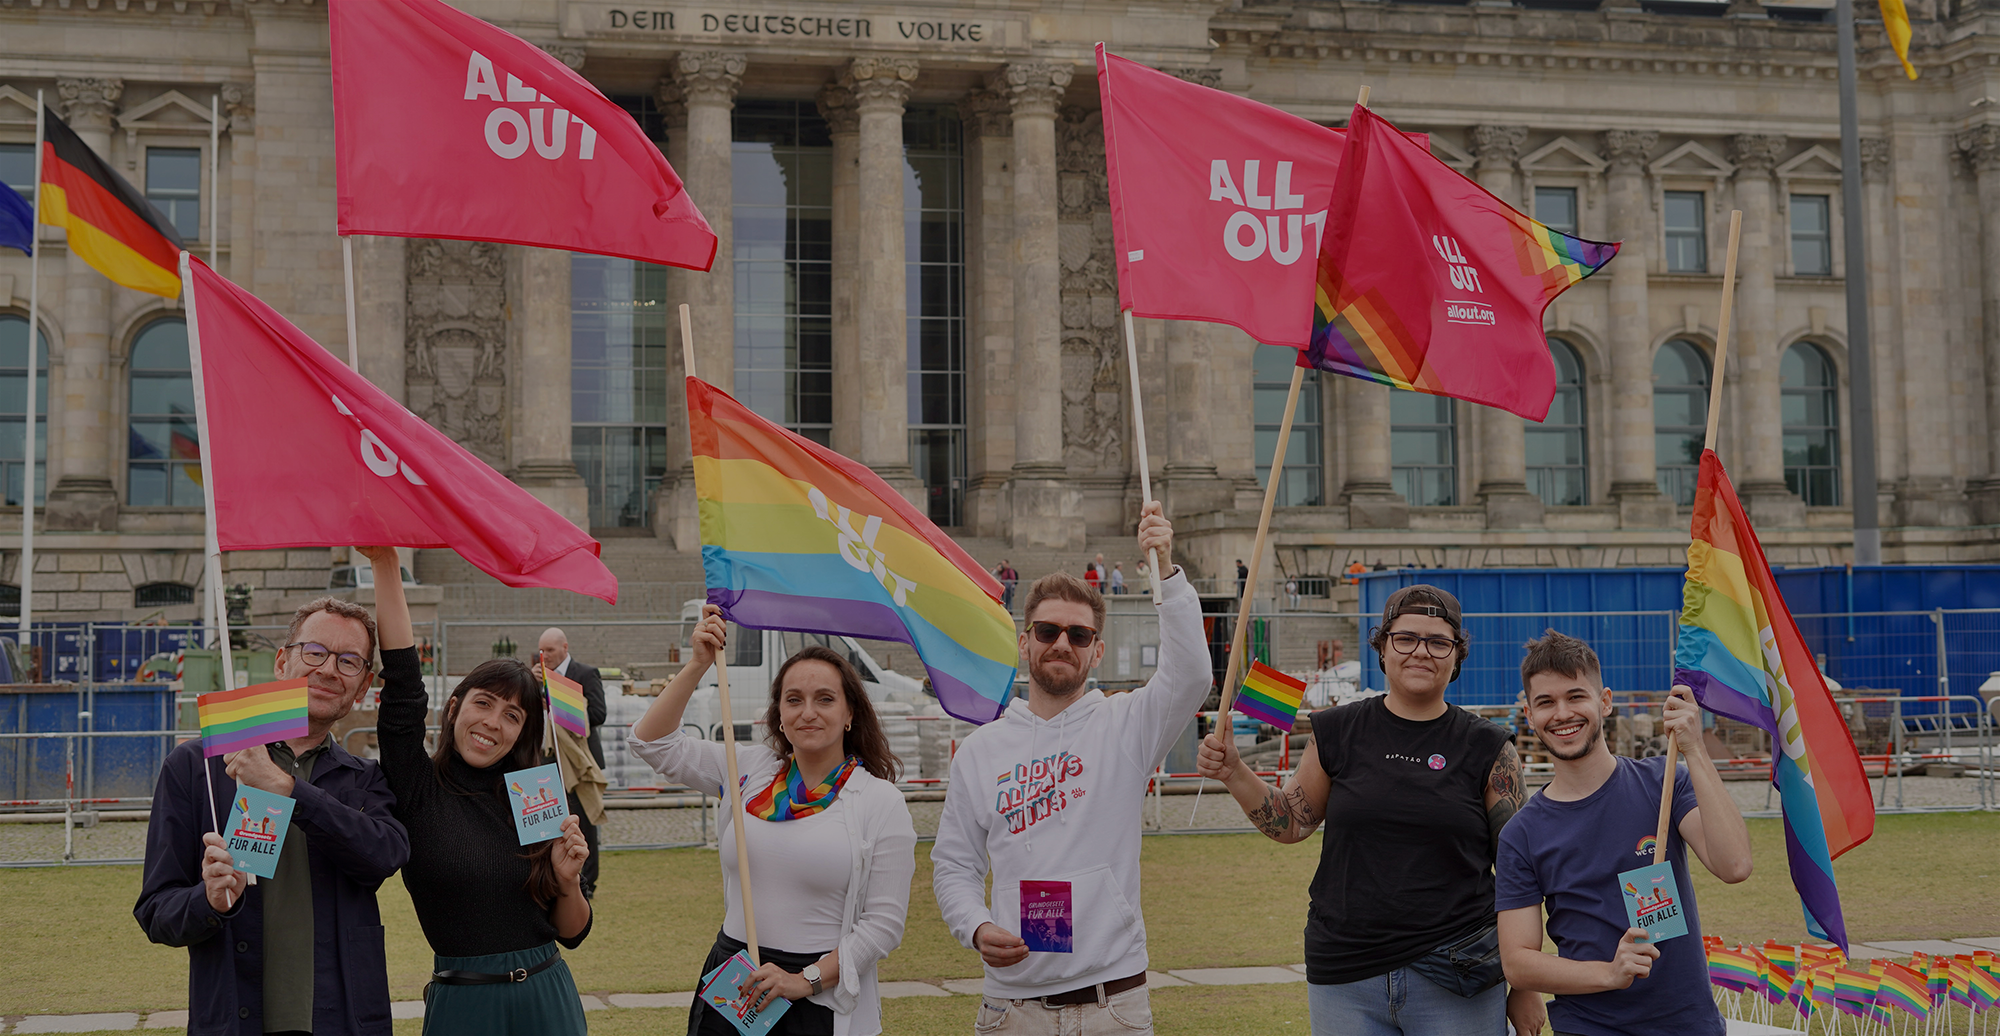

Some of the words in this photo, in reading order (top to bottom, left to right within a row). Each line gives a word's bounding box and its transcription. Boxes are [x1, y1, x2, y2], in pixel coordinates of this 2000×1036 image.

[609, 9, 675, 31] DEM
[701, 13, 872, 38] DEUTSCHEN
[897, 21, 983, 42] VOLKE
[464, 50, 556, 103] AL
[484, 107, 598, 160] OUT
[1209, 159, 1305, 210] ALL
[1432, 234, 1467, 264] ALL
[1448, 263, 1483, 293] OUT
[1447, 304, 1495, 326] allout.org
[1070, 787, 1082, 795] ALL
[1073, 790, 1086, 799] OUT
[542, 805, 564, 822] ALLE
[250, 841, 277, 855] ALLE
[1045, 907, 1066, 918] ALLE
[1656, 905, 1678, 922] ALLE
